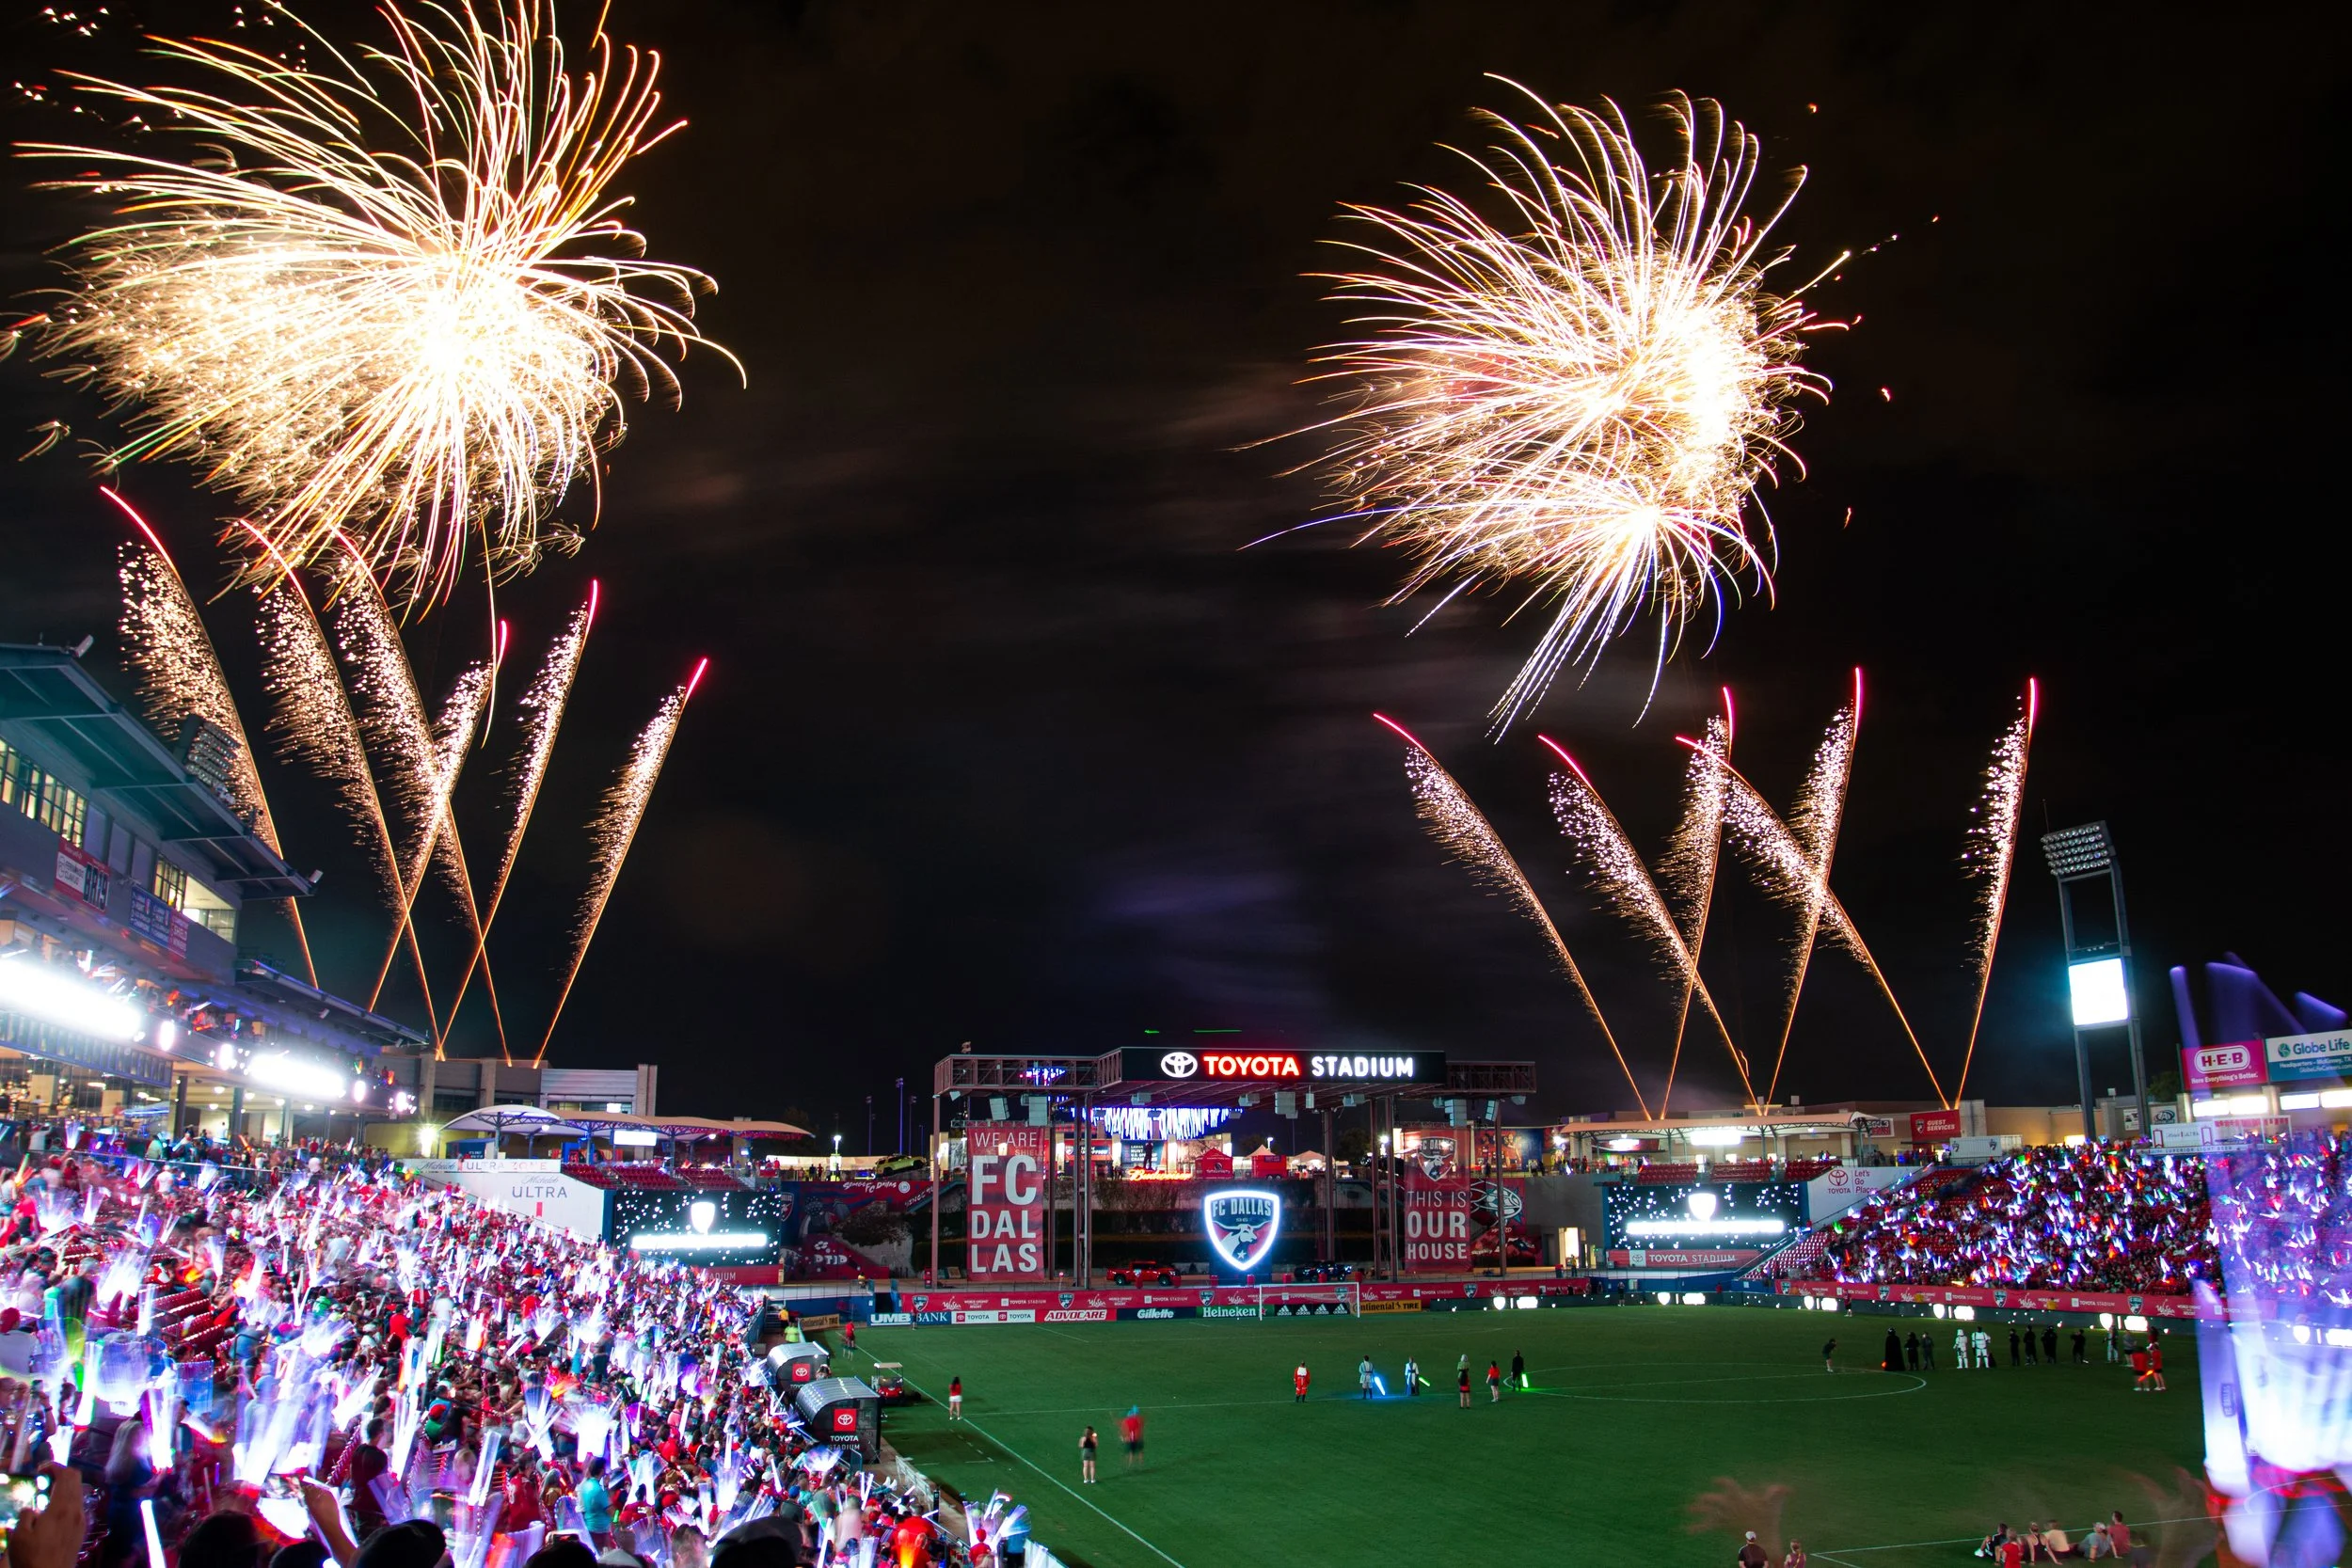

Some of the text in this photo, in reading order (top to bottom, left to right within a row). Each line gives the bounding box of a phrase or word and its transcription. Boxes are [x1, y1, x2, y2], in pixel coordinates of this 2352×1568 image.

[2293, 1037, 2350, 1055] Globe Life
[1203, 1055, 1414, 1078] TOYOTA STADIUM
[975, 1132, 1037, 1148] WE ARE
[972, 1155, 1037, 1205] FC
[512, 1186, 567, 1197] ULTRA
[1407, 1191, 1467, 1208] THIS IS
[1212, 1198, 1272, 1217] FC DALLAS
[972, 1211, 1036, 1239] DAL
[1407, 1212, 1466, 1238] OUR
[972, 1243, 1037, 1273] LAS
[1407, 1243, 1468, 1259] HOUSE
[1649, 1254, 1736, 1262] TOYOTA STADIUM
[870, 1311, 947, 1323] UMB BANK
[1044, 1308, 1107, 1322] ADVOCARE
[1136, 1308, 1175, 1319] Gillette
[1202, 1306, 1256, 1318] Heineken
